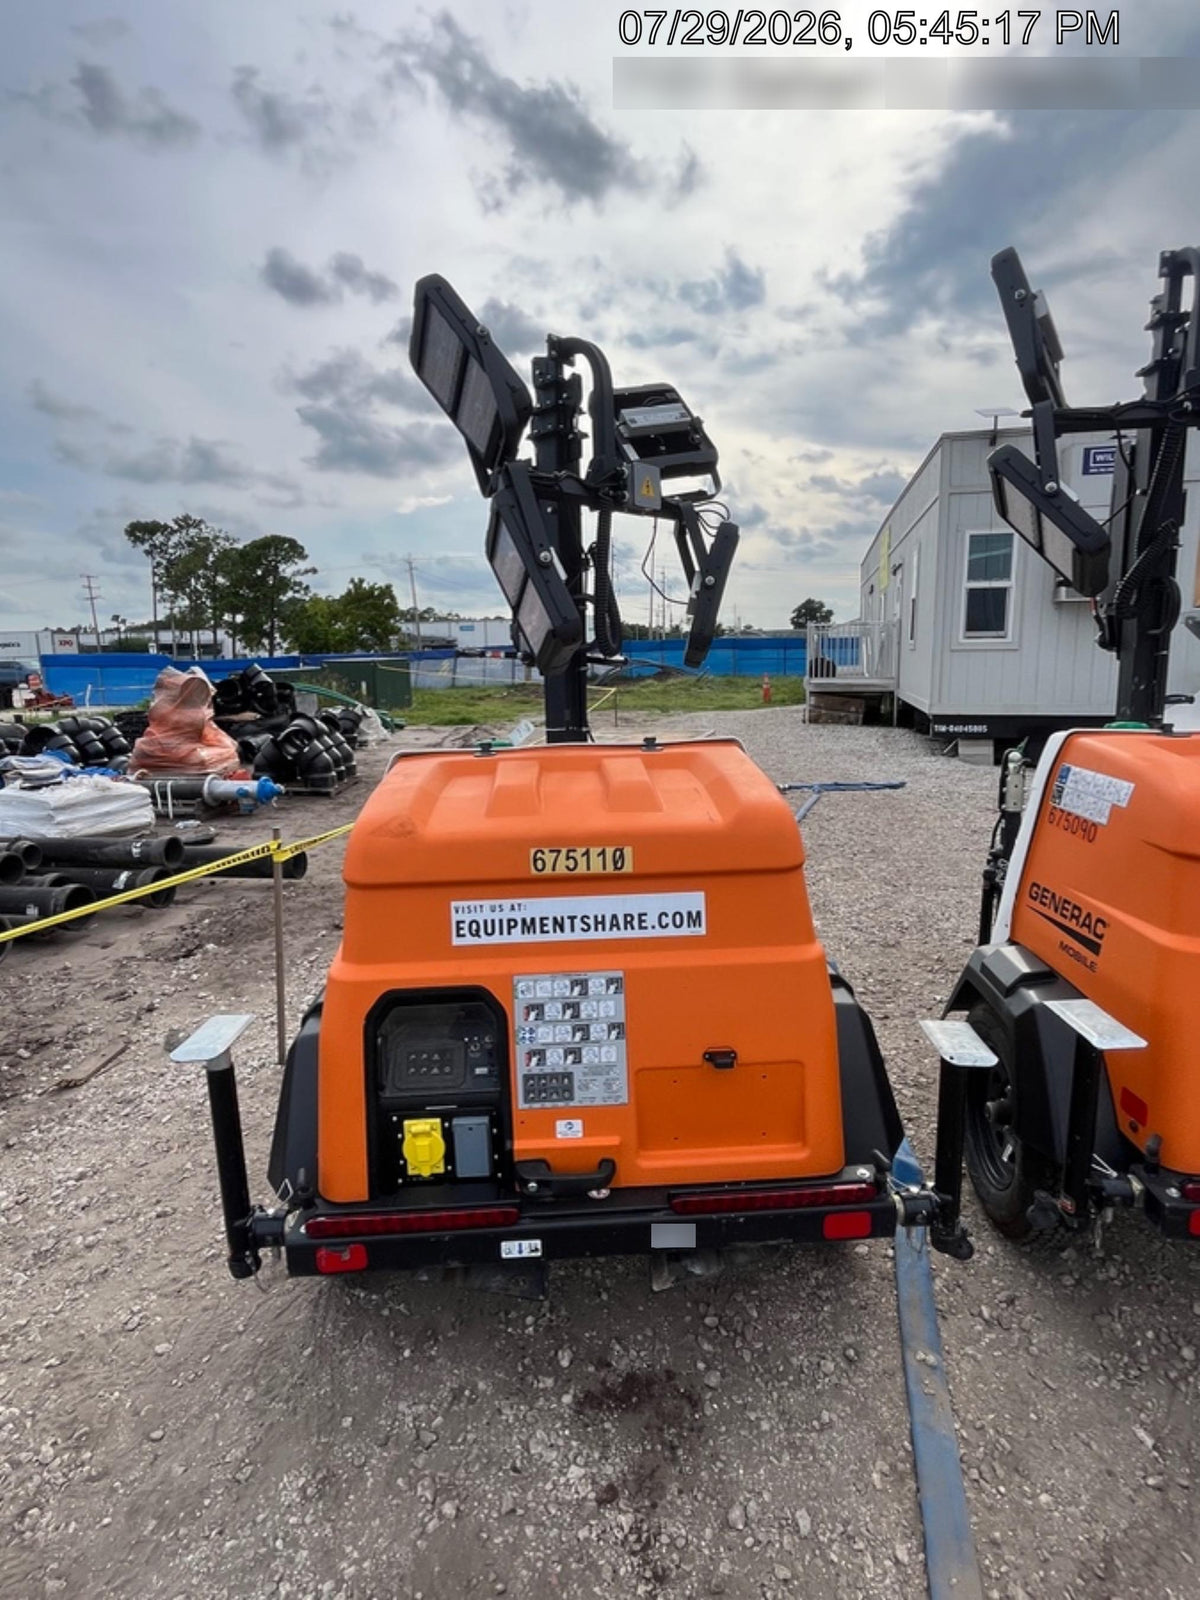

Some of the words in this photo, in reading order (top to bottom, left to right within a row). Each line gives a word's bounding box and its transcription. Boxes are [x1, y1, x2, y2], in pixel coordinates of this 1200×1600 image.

[1048, 806, 1098, 844] 675090
[532, 847, 626, 873] 675110
[453, 904, 484, 915] VISIT
[489, 903, 504, 913] US
[509, 902, 527, 912] AT:
[455, 909, 703, 939] EQUIPMENTSHARE.COM
[1029, 882, 1107, 940] GENERAC
[1059, 941, 1098, 973] MOBILE
